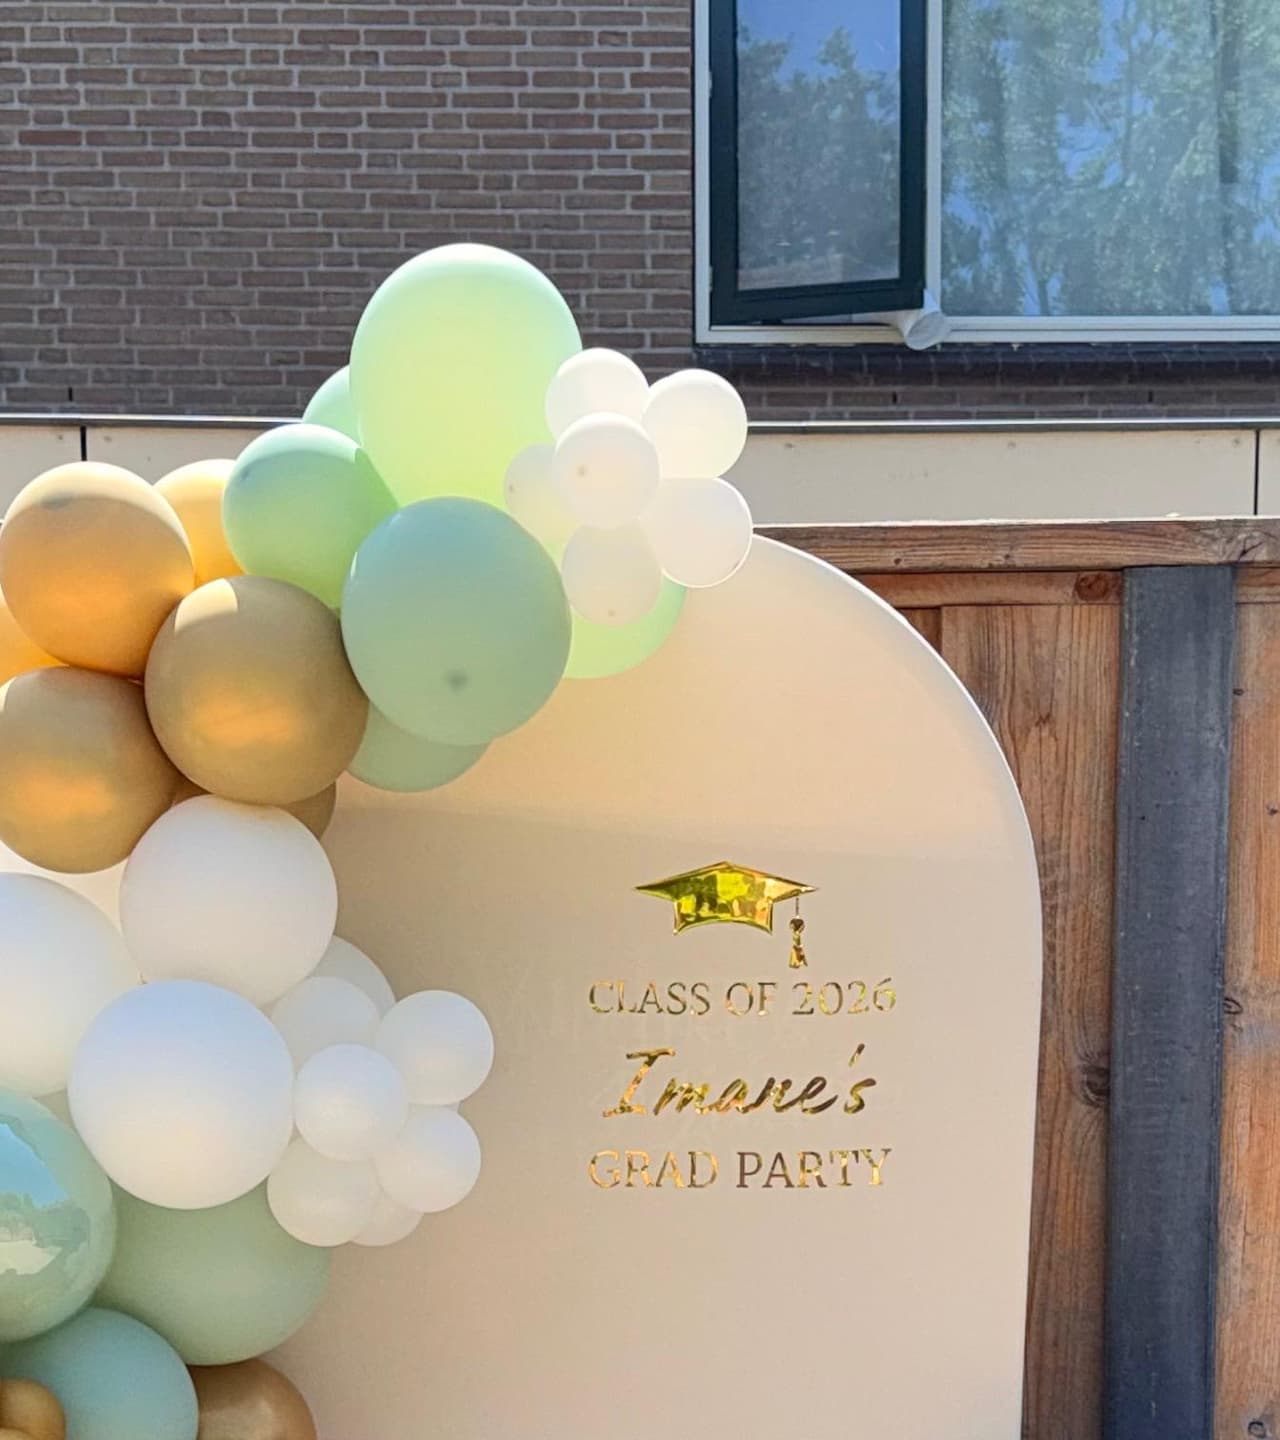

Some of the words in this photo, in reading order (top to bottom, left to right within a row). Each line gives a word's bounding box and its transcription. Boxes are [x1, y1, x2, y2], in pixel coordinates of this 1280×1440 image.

[589, 979, 711, 1015] CLASS
[726, 981, 778, 1016] OF
[792, 977, 897, 1016] 2026
[602, 1043, 877, 1117] Imane's
[588, 1150, 718, 1189] GRAD
[736, 1148, 892, 1188] PARTY
